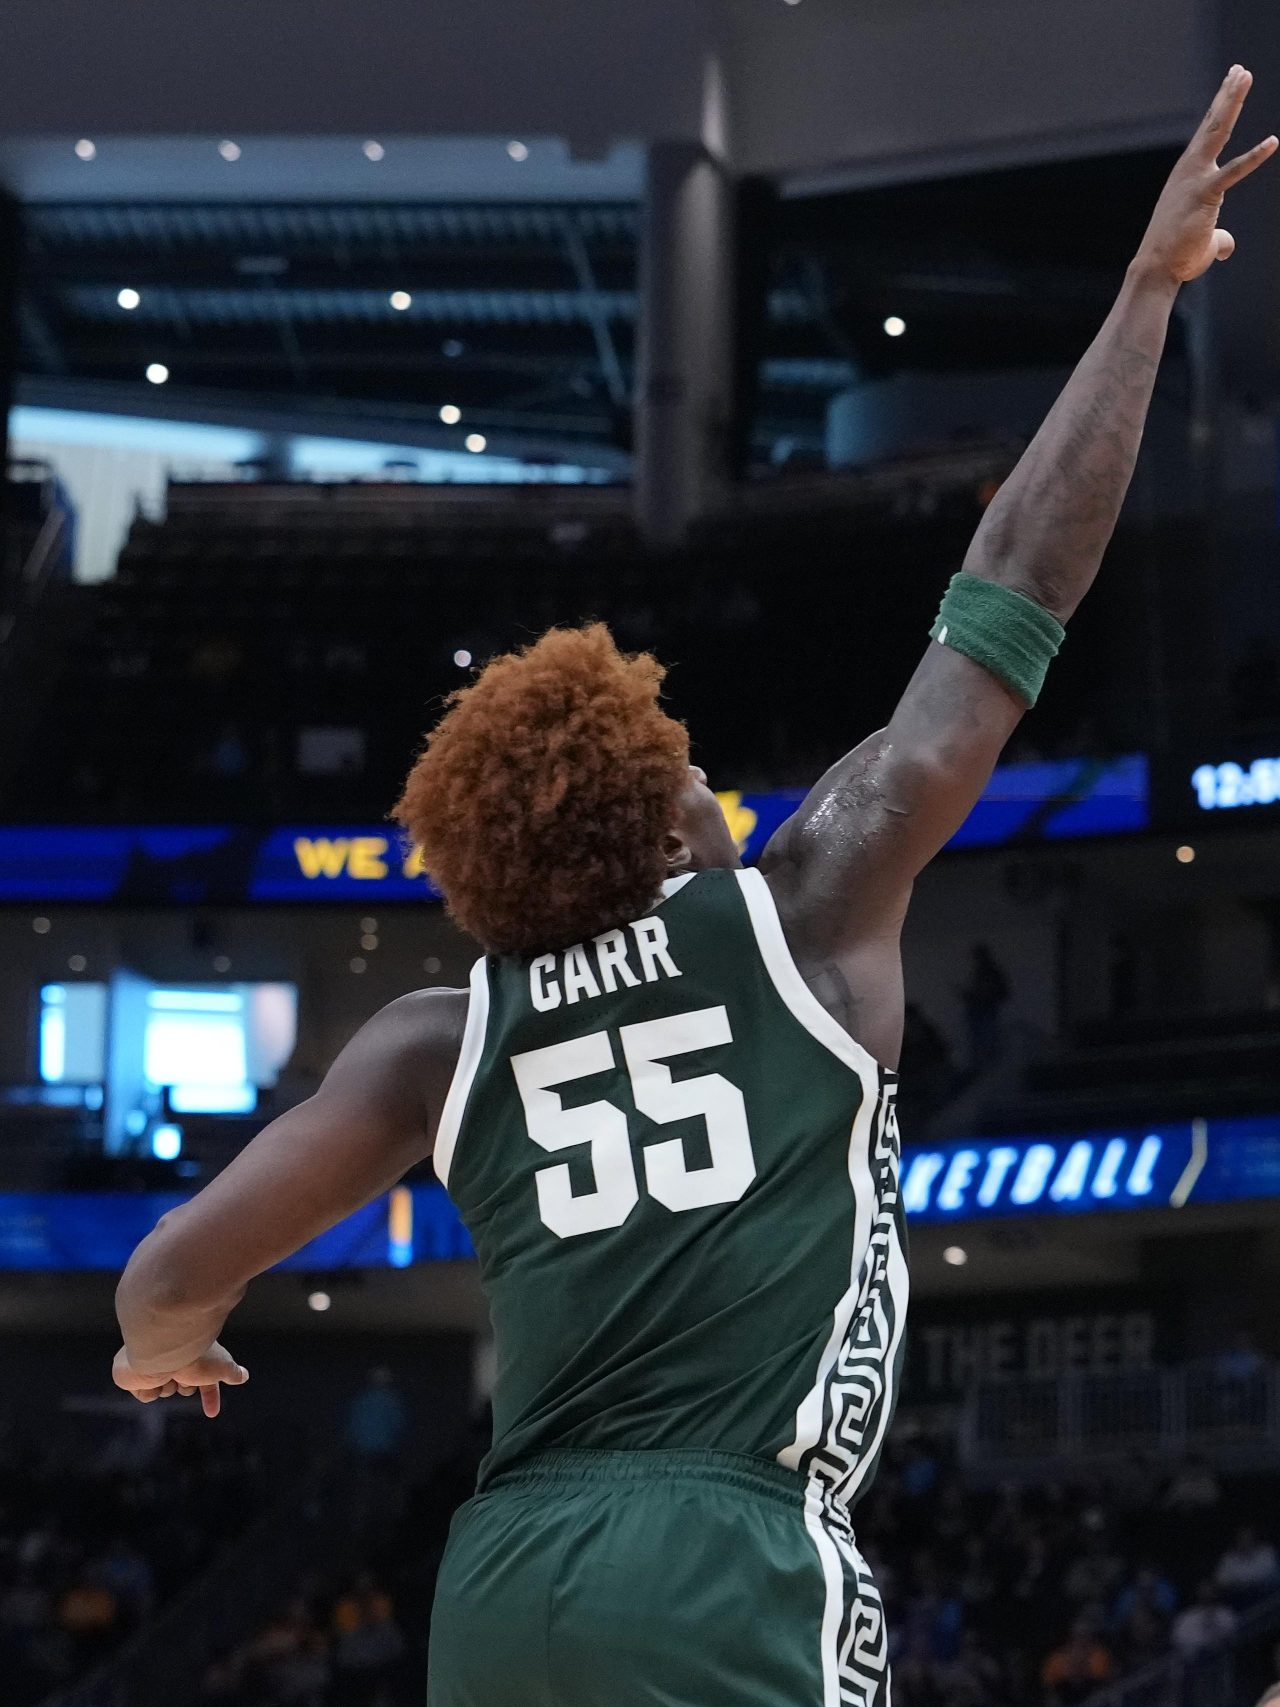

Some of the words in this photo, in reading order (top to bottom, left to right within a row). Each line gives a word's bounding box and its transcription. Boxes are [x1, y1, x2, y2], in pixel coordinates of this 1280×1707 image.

[294, 836, 389, 880] WE
[529, 915, 683, 1013] CARR
[510, 1005, 757, 1239] 55
[899, 1134, 1162, 1214] KETBALL
